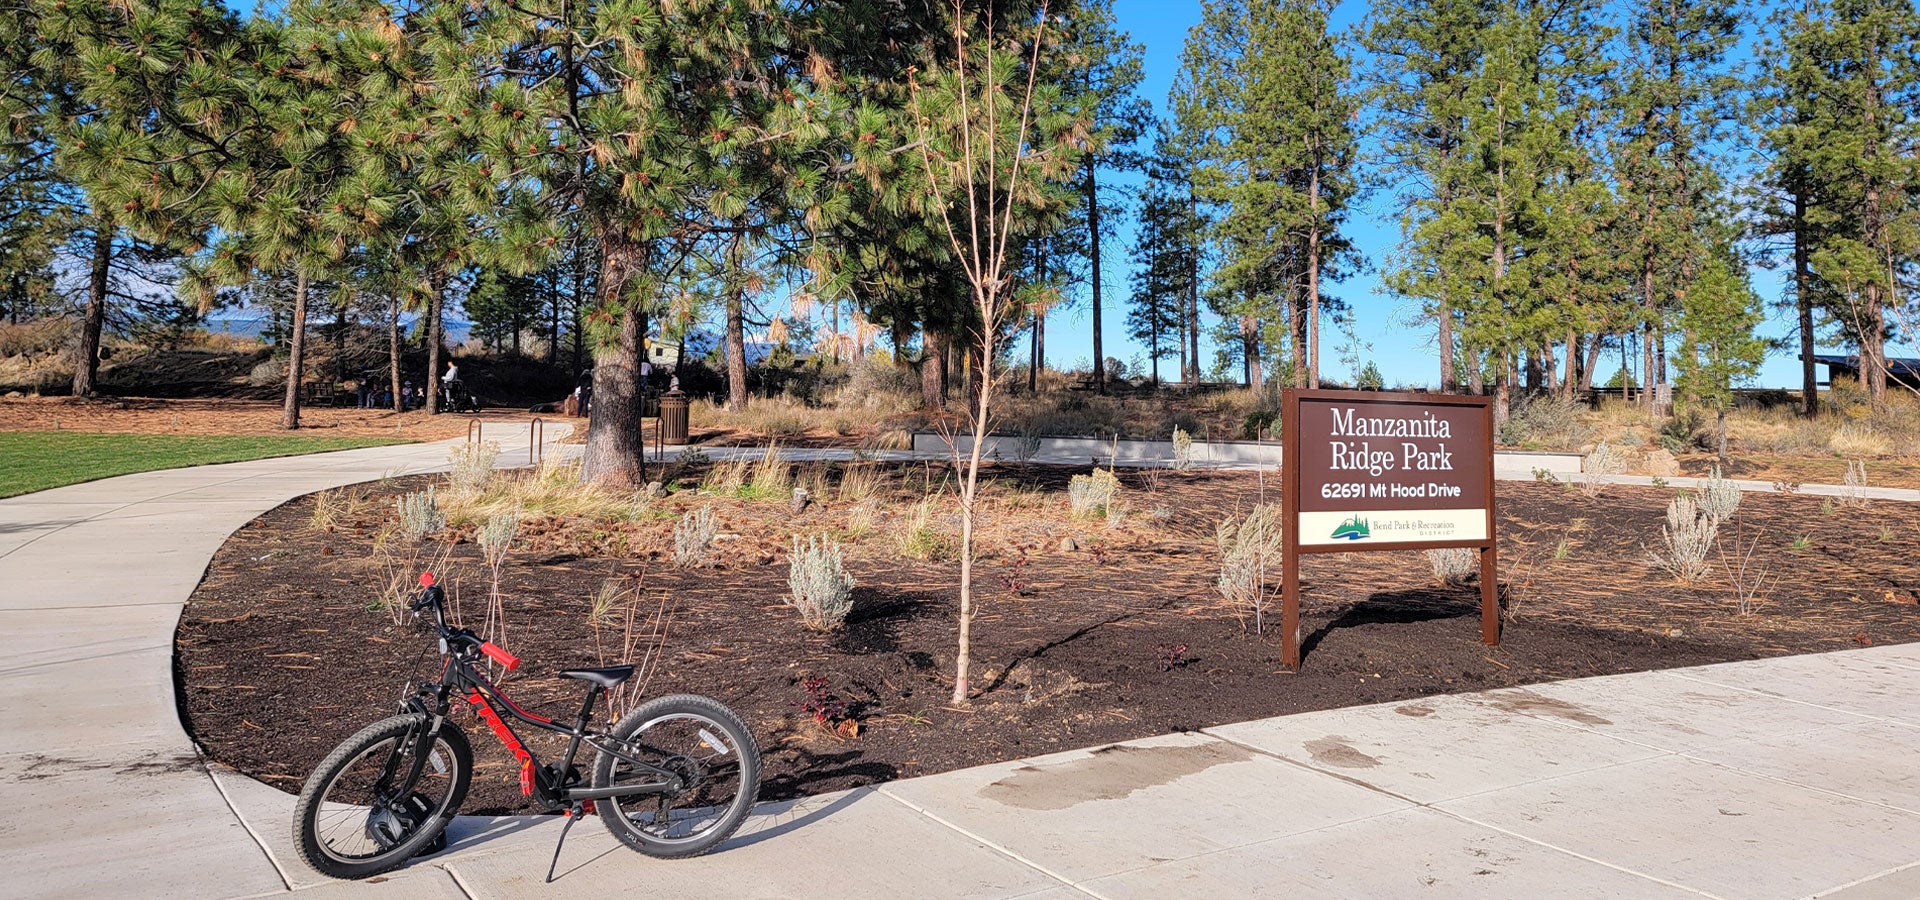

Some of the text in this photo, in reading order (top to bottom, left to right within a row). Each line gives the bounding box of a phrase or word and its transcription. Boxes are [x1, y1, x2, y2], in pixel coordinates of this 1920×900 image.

[1330, 407, 1451, 438] Manzanita
[1330, 441, 1453, 476] Ridge Park
[1321, 483, 1462, 498] 62691 Mt Hood Drive
[1373, 519, 1455, 530] Bend Park & Recreation
[467, 687, 532, 764] TREK
